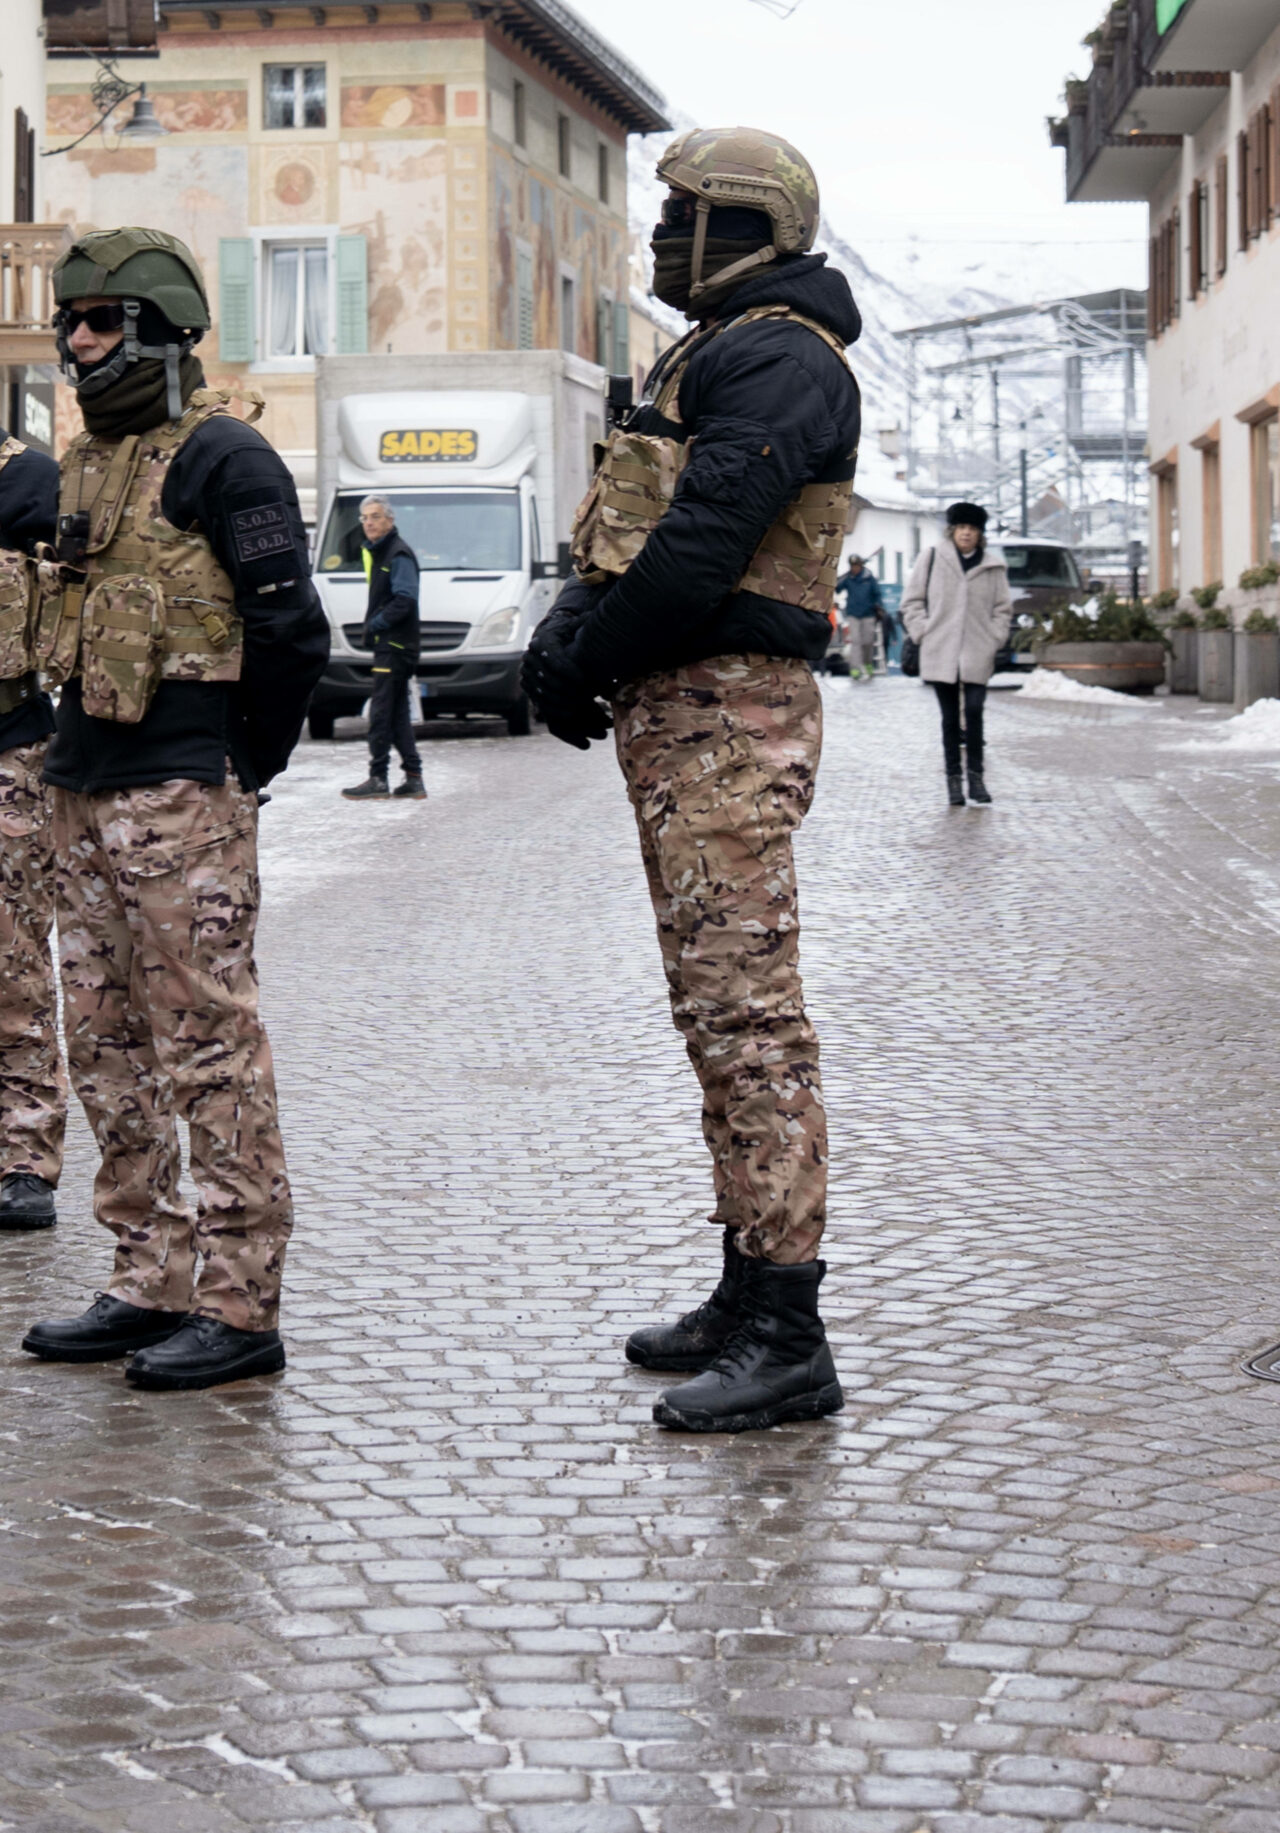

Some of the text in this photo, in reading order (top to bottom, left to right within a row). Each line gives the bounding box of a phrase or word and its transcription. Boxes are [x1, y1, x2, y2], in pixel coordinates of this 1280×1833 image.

[382, 431, 475, 456] SADES
[236, 510, 283, 530] S.O.D.
[242, 534, 289, 555] S.O.D.
